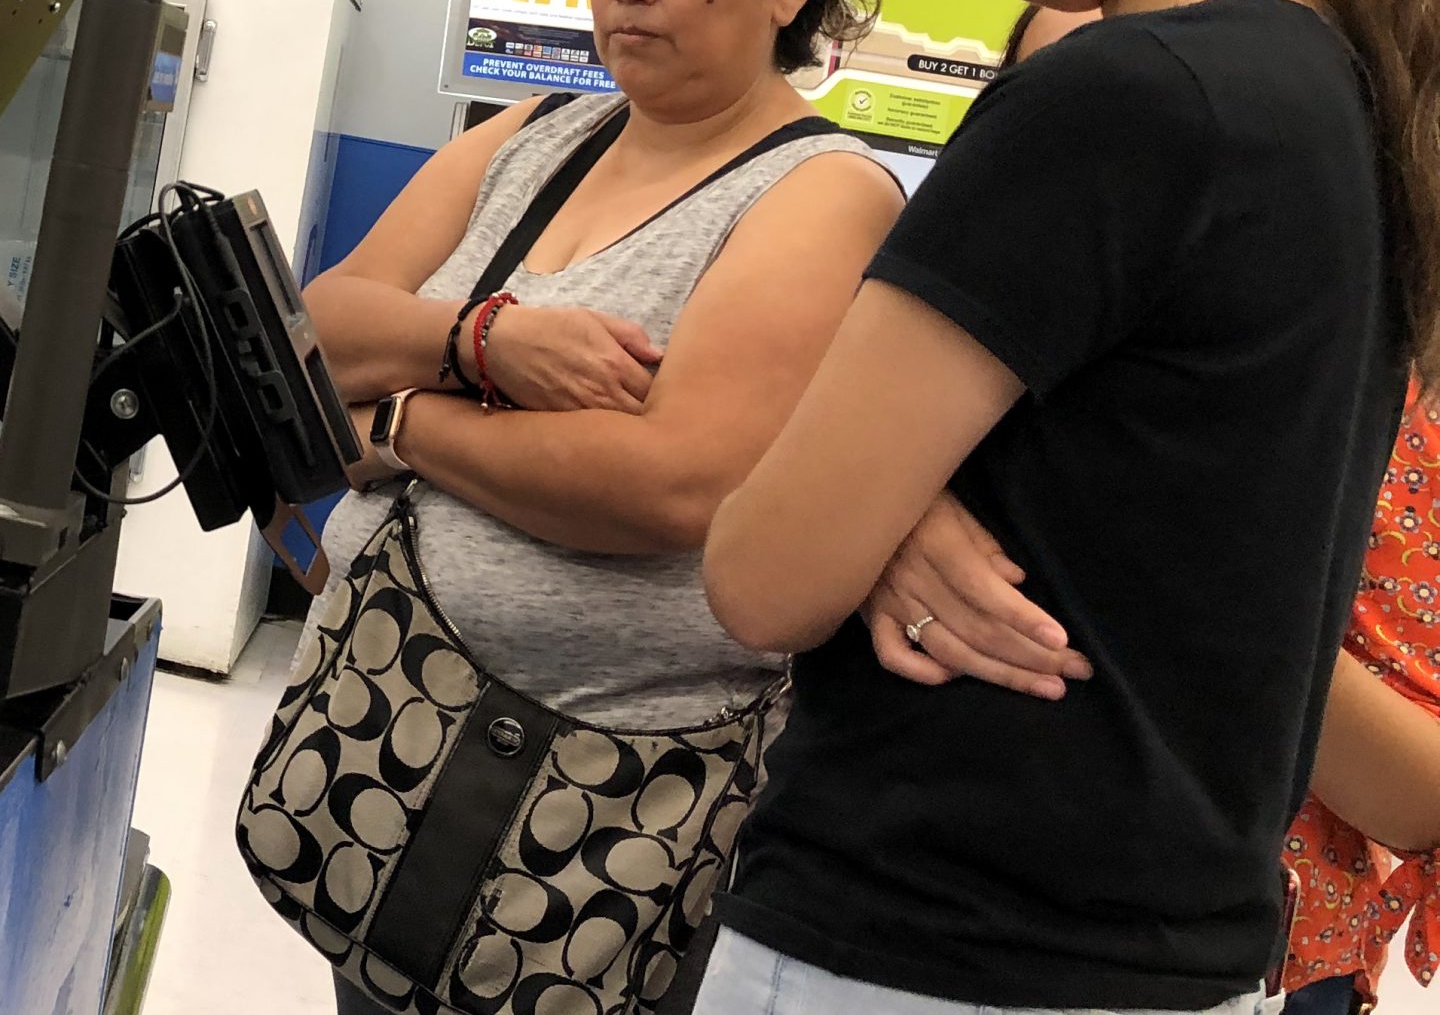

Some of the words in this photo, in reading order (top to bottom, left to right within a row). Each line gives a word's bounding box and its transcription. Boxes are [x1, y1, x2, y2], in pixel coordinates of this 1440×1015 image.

[469, 64, 500, 76] CHECK
[501, 68, 527, 79] YOUR
[528, 71, 571, 84] BALANCE
[573, 76, 592, 86] FOR
[593, 79, 616, 89] FREE
[483, 58, 523, 70] PREVENT
[526, 63, 580, 78] OVERDRAFT
[582, 69, 605, 79] FEES
[918, 59, 938, 71] BUY
[940, 63, 947, 73] 2
[949, 64, 969, 77] GET
[972, 67, 976, 77] 1
[979, 69, 998, 80] BO
[908, 145, 938, 158] Walmart
